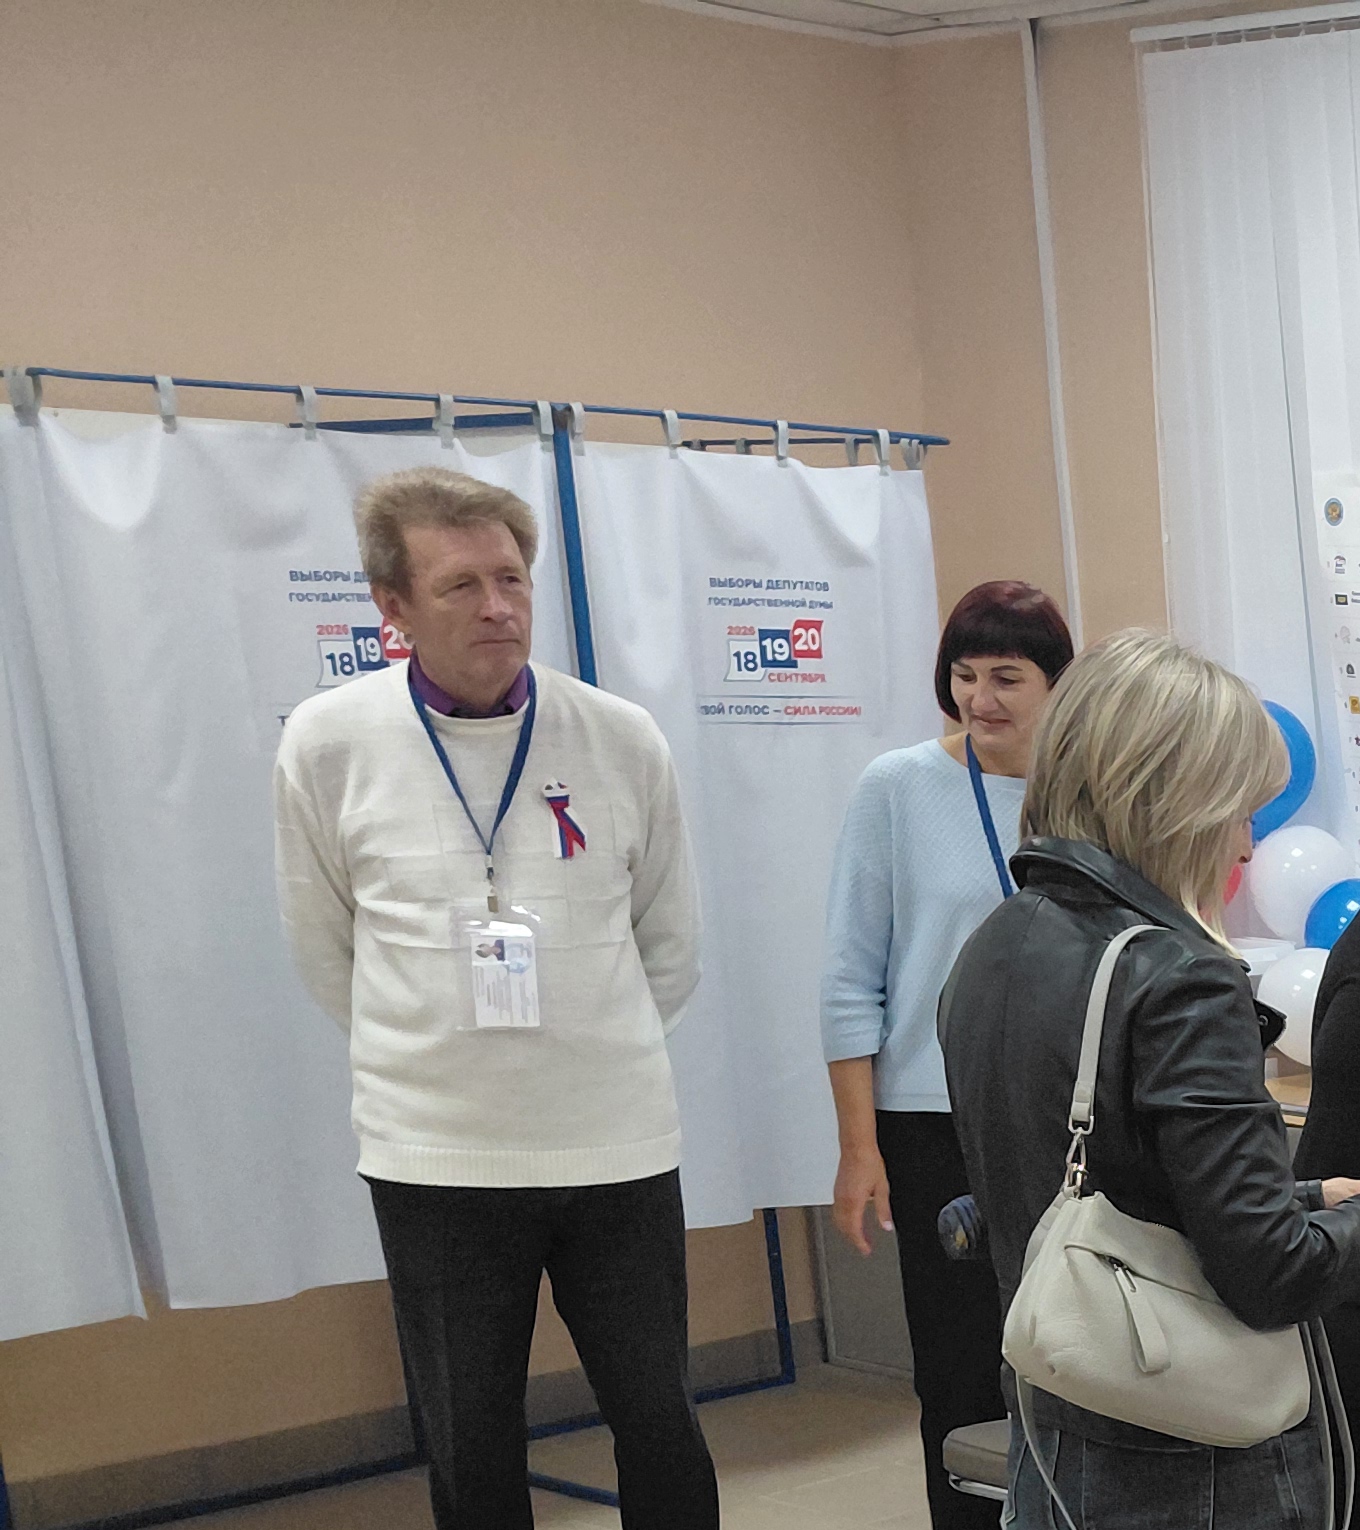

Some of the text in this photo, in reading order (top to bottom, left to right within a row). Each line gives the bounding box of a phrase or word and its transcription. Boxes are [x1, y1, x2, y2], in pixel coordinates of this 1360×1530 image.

[289, 570, 351, 582] ВЫБОРЫ
[709, 577, 829, 591] ВЫБОРЫ ДЕПУТАТОВ
[289, 592, 372, 603] ГОСУДАРСТВЕН
[708, 597, 806, 608] ГОСУДАРСТВЕННОЙ
[316, 624, 349, 636] 2026
[732, 627, 820, 672] 18 19 20
[325, 652, 355, 676] 18
[356, 637, 381, 663] 19
[767, 672, 826, 683] СЕНТЯБРЯ
[700, 703, 725, 715] ВОЙ
[729, 704, 770, 715] ГОЛОС
[784, 705, 818, 715] СИЛА
[819, 705, 862, 716] РОССИИ!
